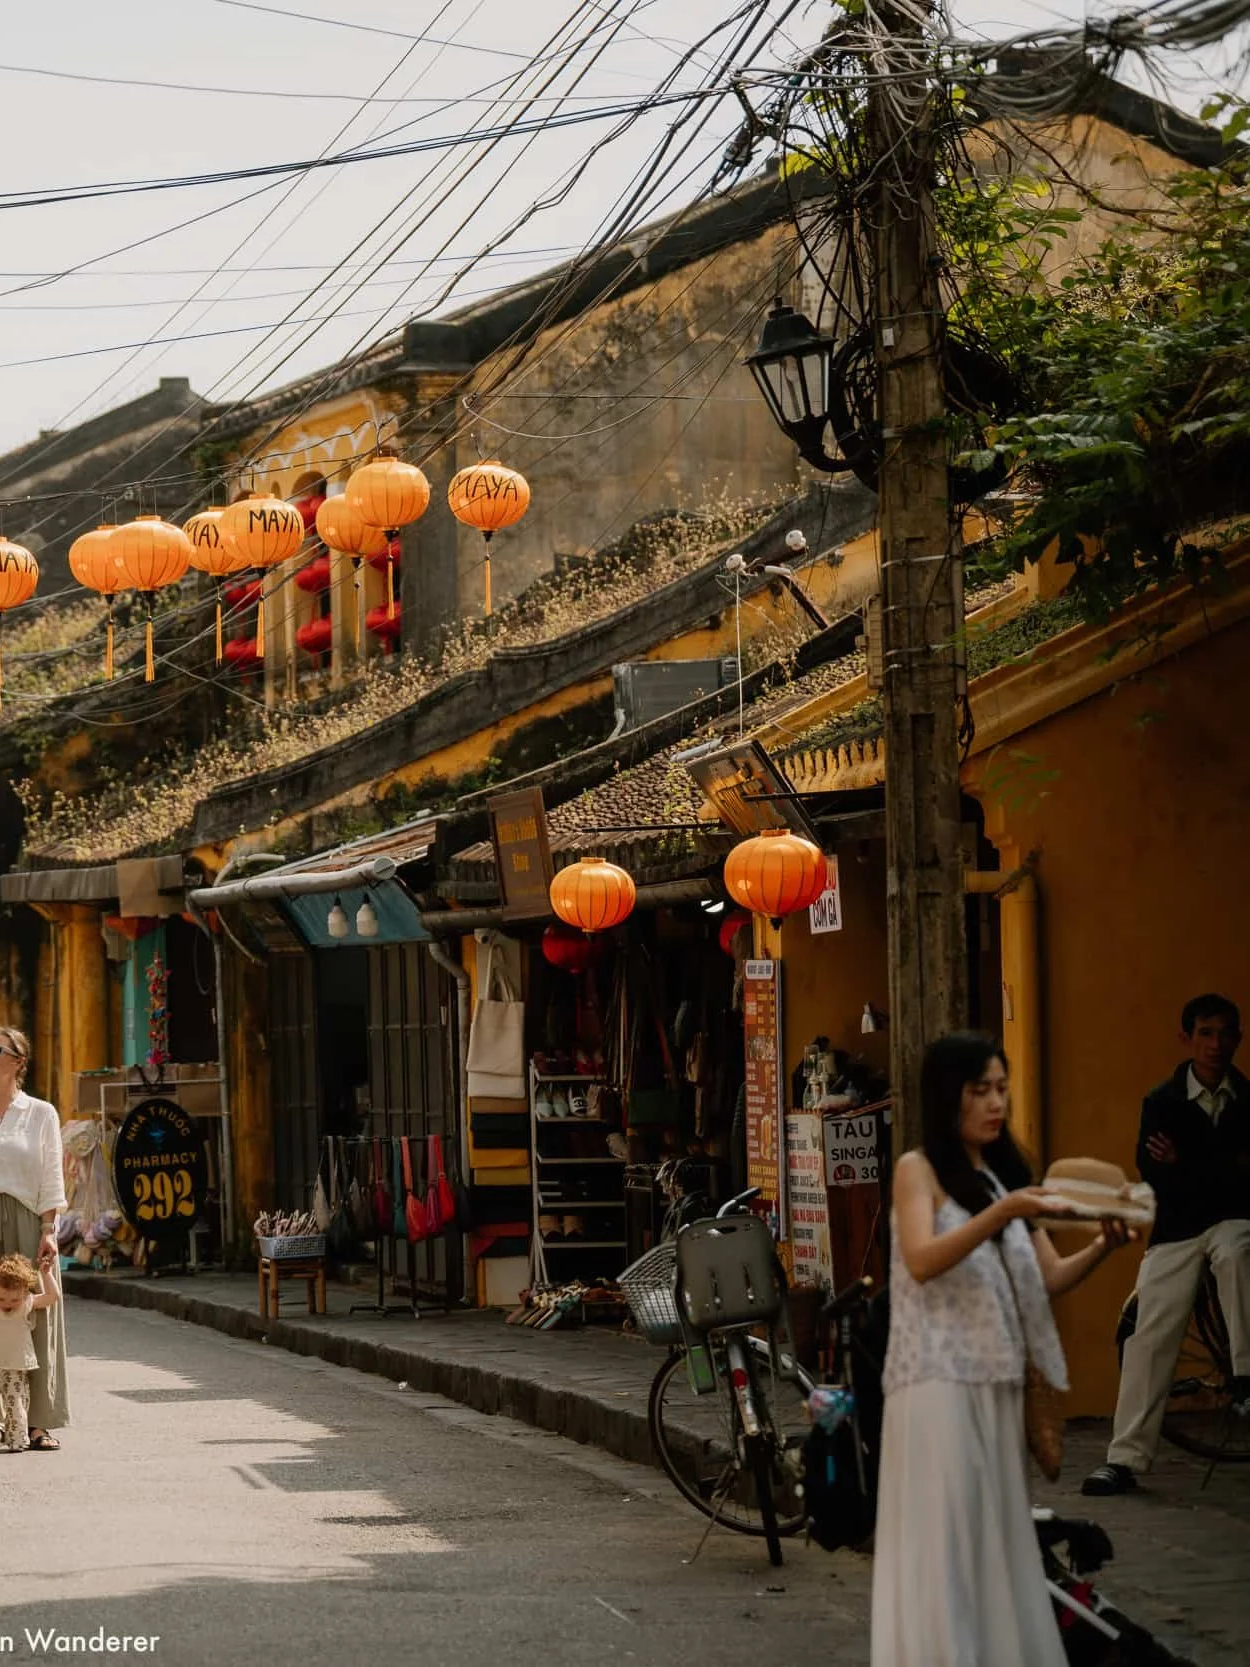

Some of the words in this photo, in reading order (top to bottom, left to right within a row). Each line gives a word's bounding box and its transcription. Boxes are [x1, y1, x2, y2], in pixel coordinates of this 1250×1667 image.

[451, 473, 518, 501] MAYA
[249, 509, 300, 534] MAYA
[123, 1151, 198, 1169] PHARMACY
[133, 1169, 195, 1221] 292
